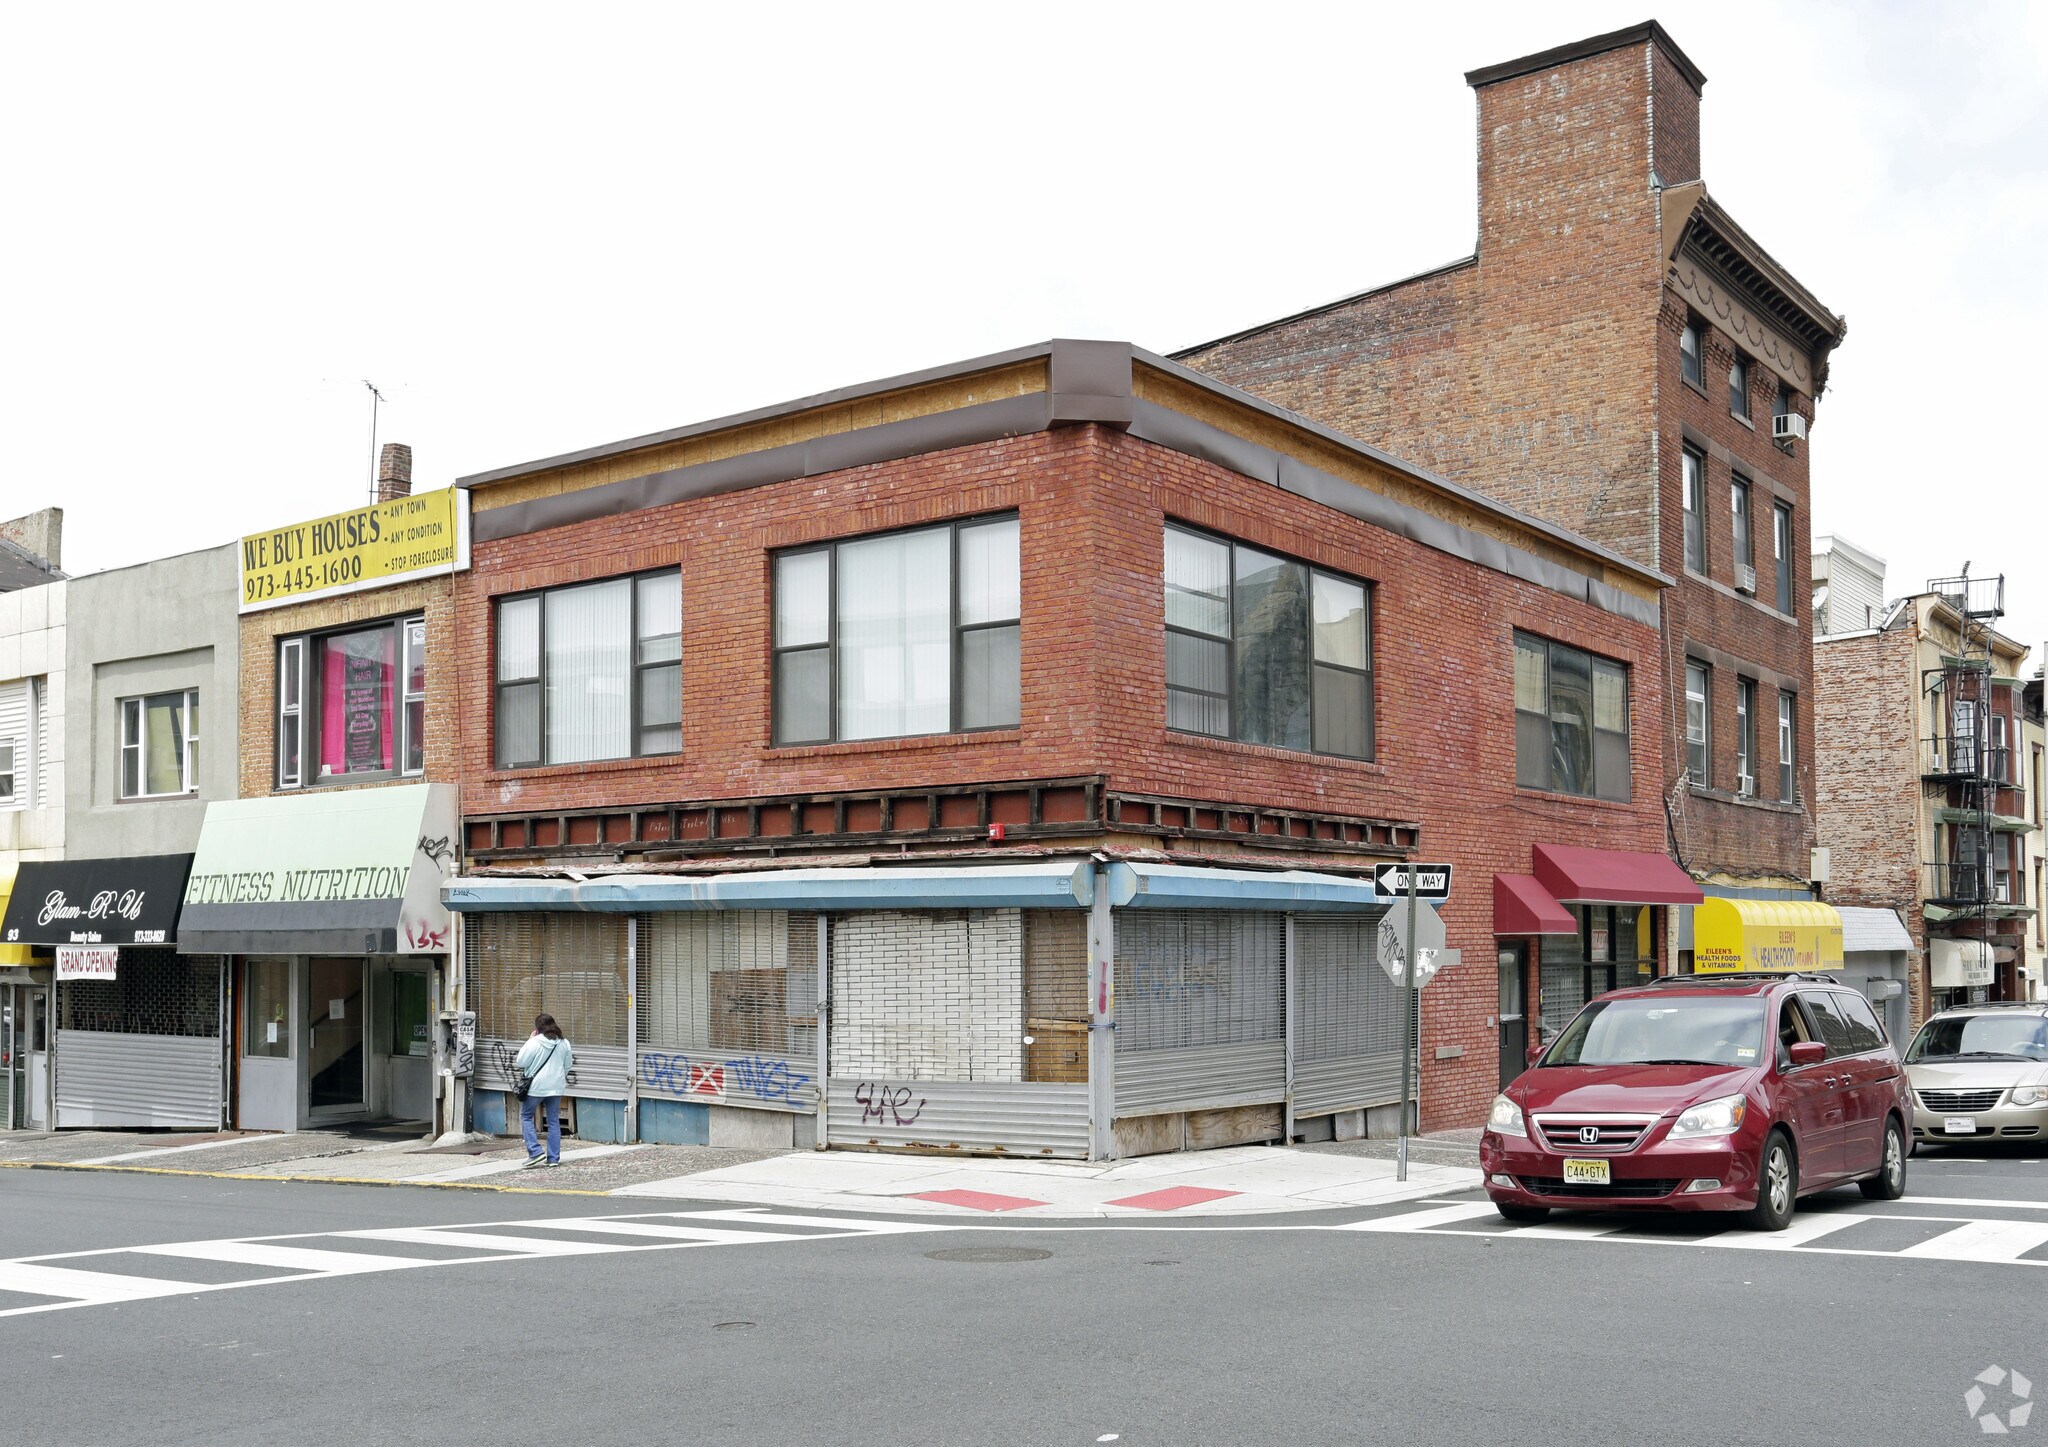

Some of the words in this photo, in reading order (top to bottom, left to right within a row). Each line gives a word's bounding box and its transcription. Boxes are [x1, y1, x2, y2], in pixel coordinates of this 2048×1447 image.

[390, 504, 403, 519] ANY
[407, 498, 427, 516] TOWN
[244, 537, 268, 572] WE
[273, 528, 305, 565] BUY
[312, 509, 381, 557] HOUSES
[391, 529, 404, 544] ANY
[407, 522, 443, 542] CONDITION
[391, 555, 407, 571] STOP
[410, 546, 454, 567] FORECLOSURE
[246, 554, 362, 601] 973-445-1600
[354, 670, 371, 682] HAIR
[185, 871, 275, 904] FITNESS
[280, 866, 410, 902] NUTRITION
[1422, 874, 1443, 888] WAY
[7, 928, 20, 941] 93
[70, 930, 88, 945] Beauty
[88, 930, 102, 943] Salon
[1779, 931, 1796, 944] EILEEN'S
[60, 951, 84, 973] GRAND
[86, 951, 117, 973] OPENING
